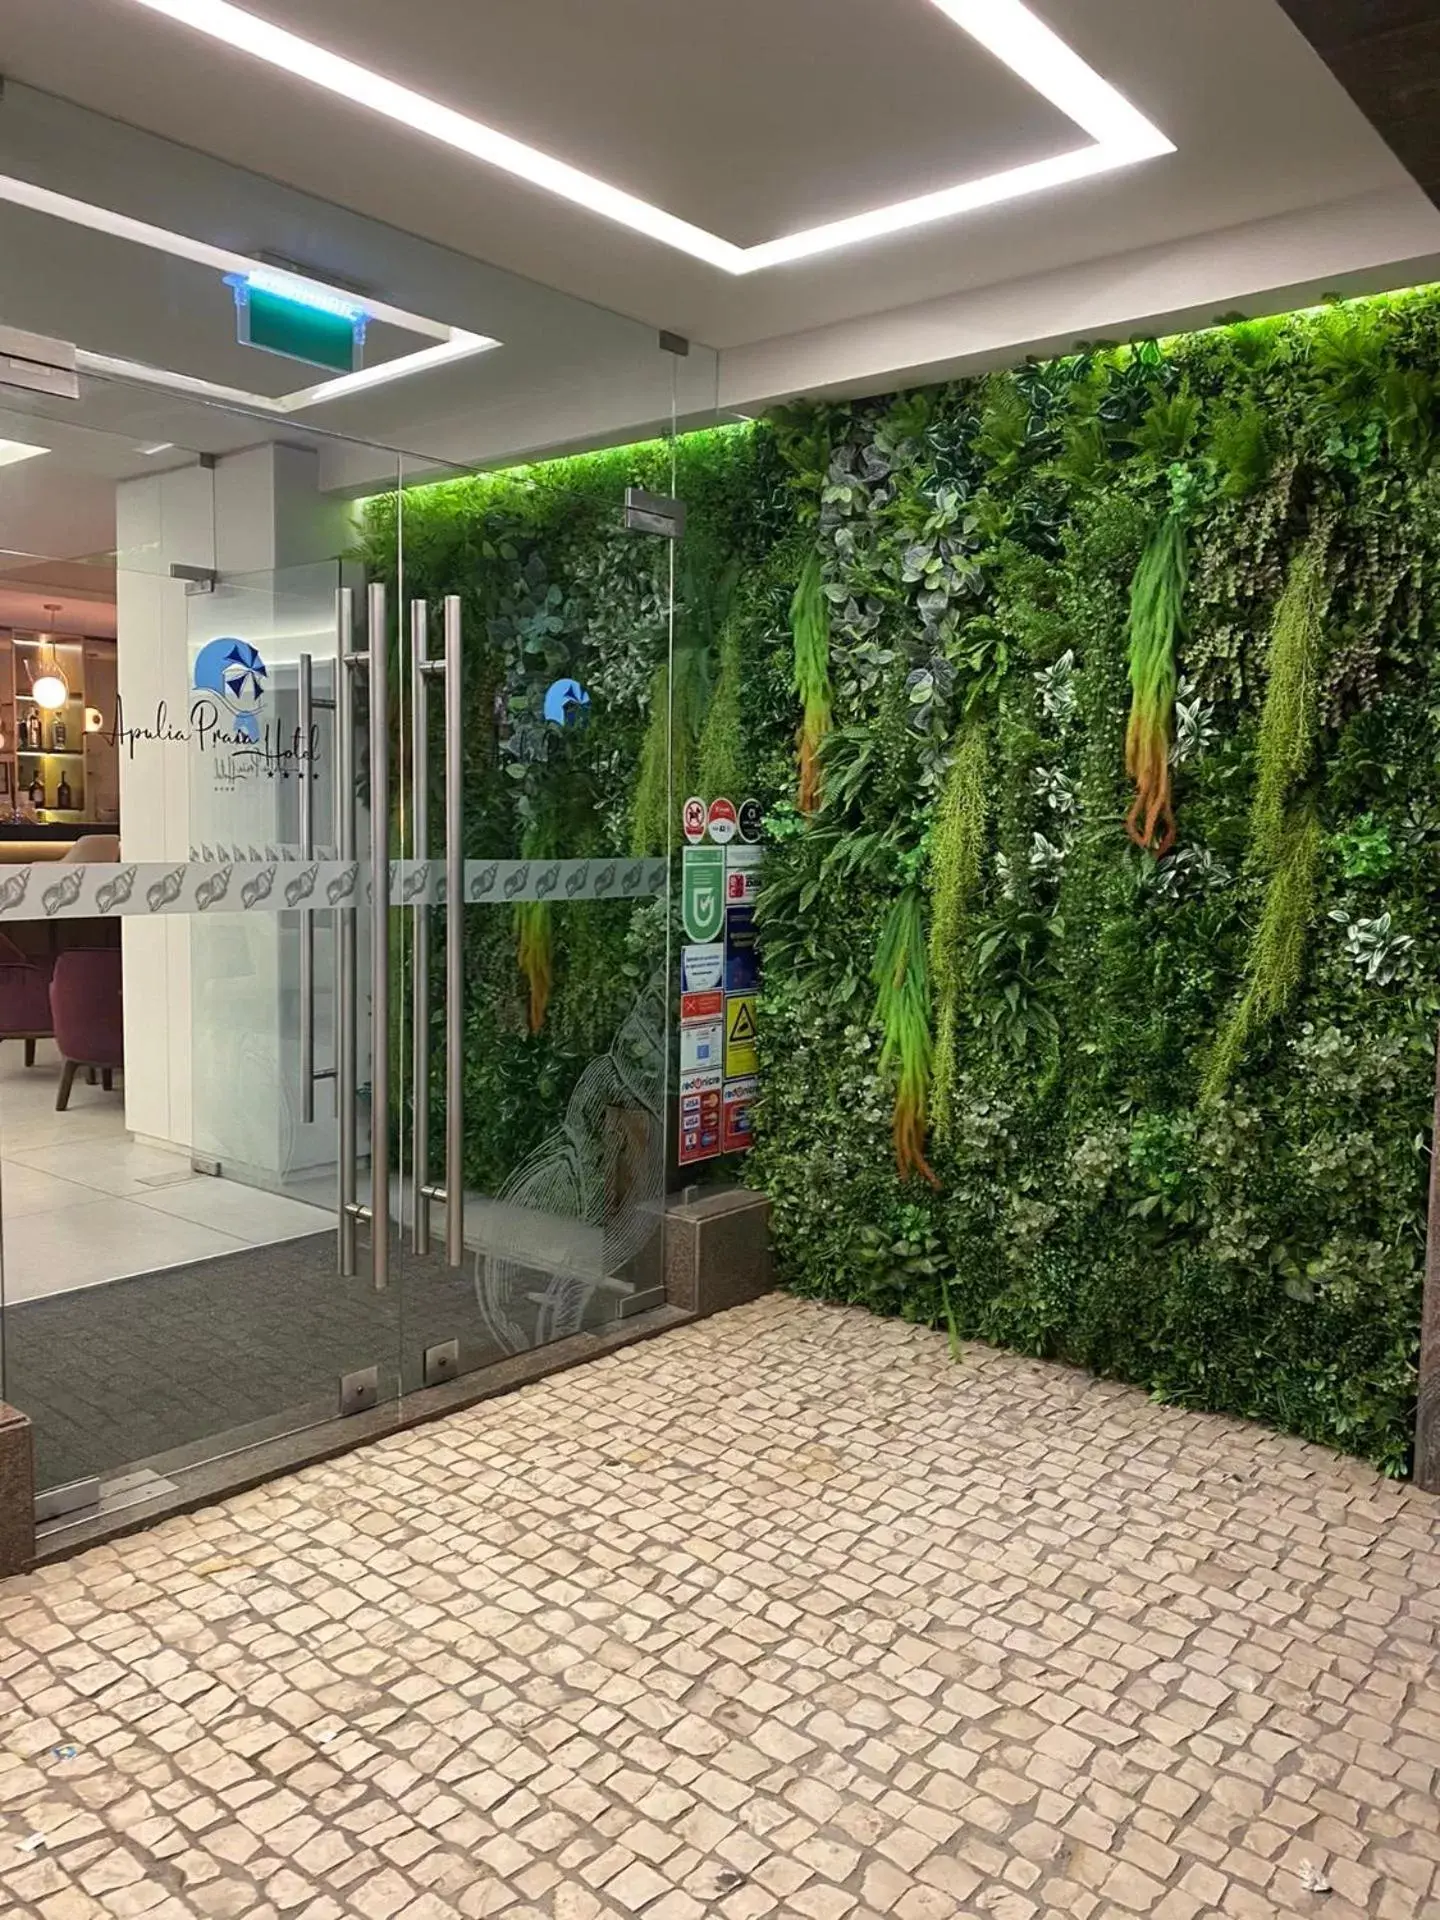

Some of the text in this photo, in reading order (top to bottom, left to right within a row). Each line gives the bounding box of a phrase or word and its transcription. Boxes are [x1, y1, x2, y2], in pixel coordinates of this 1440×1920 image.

[84, 694, 194, 760] Apulia
[190, 700, 259, 751] Praia
[231, 717, 322, 767] Hotel
